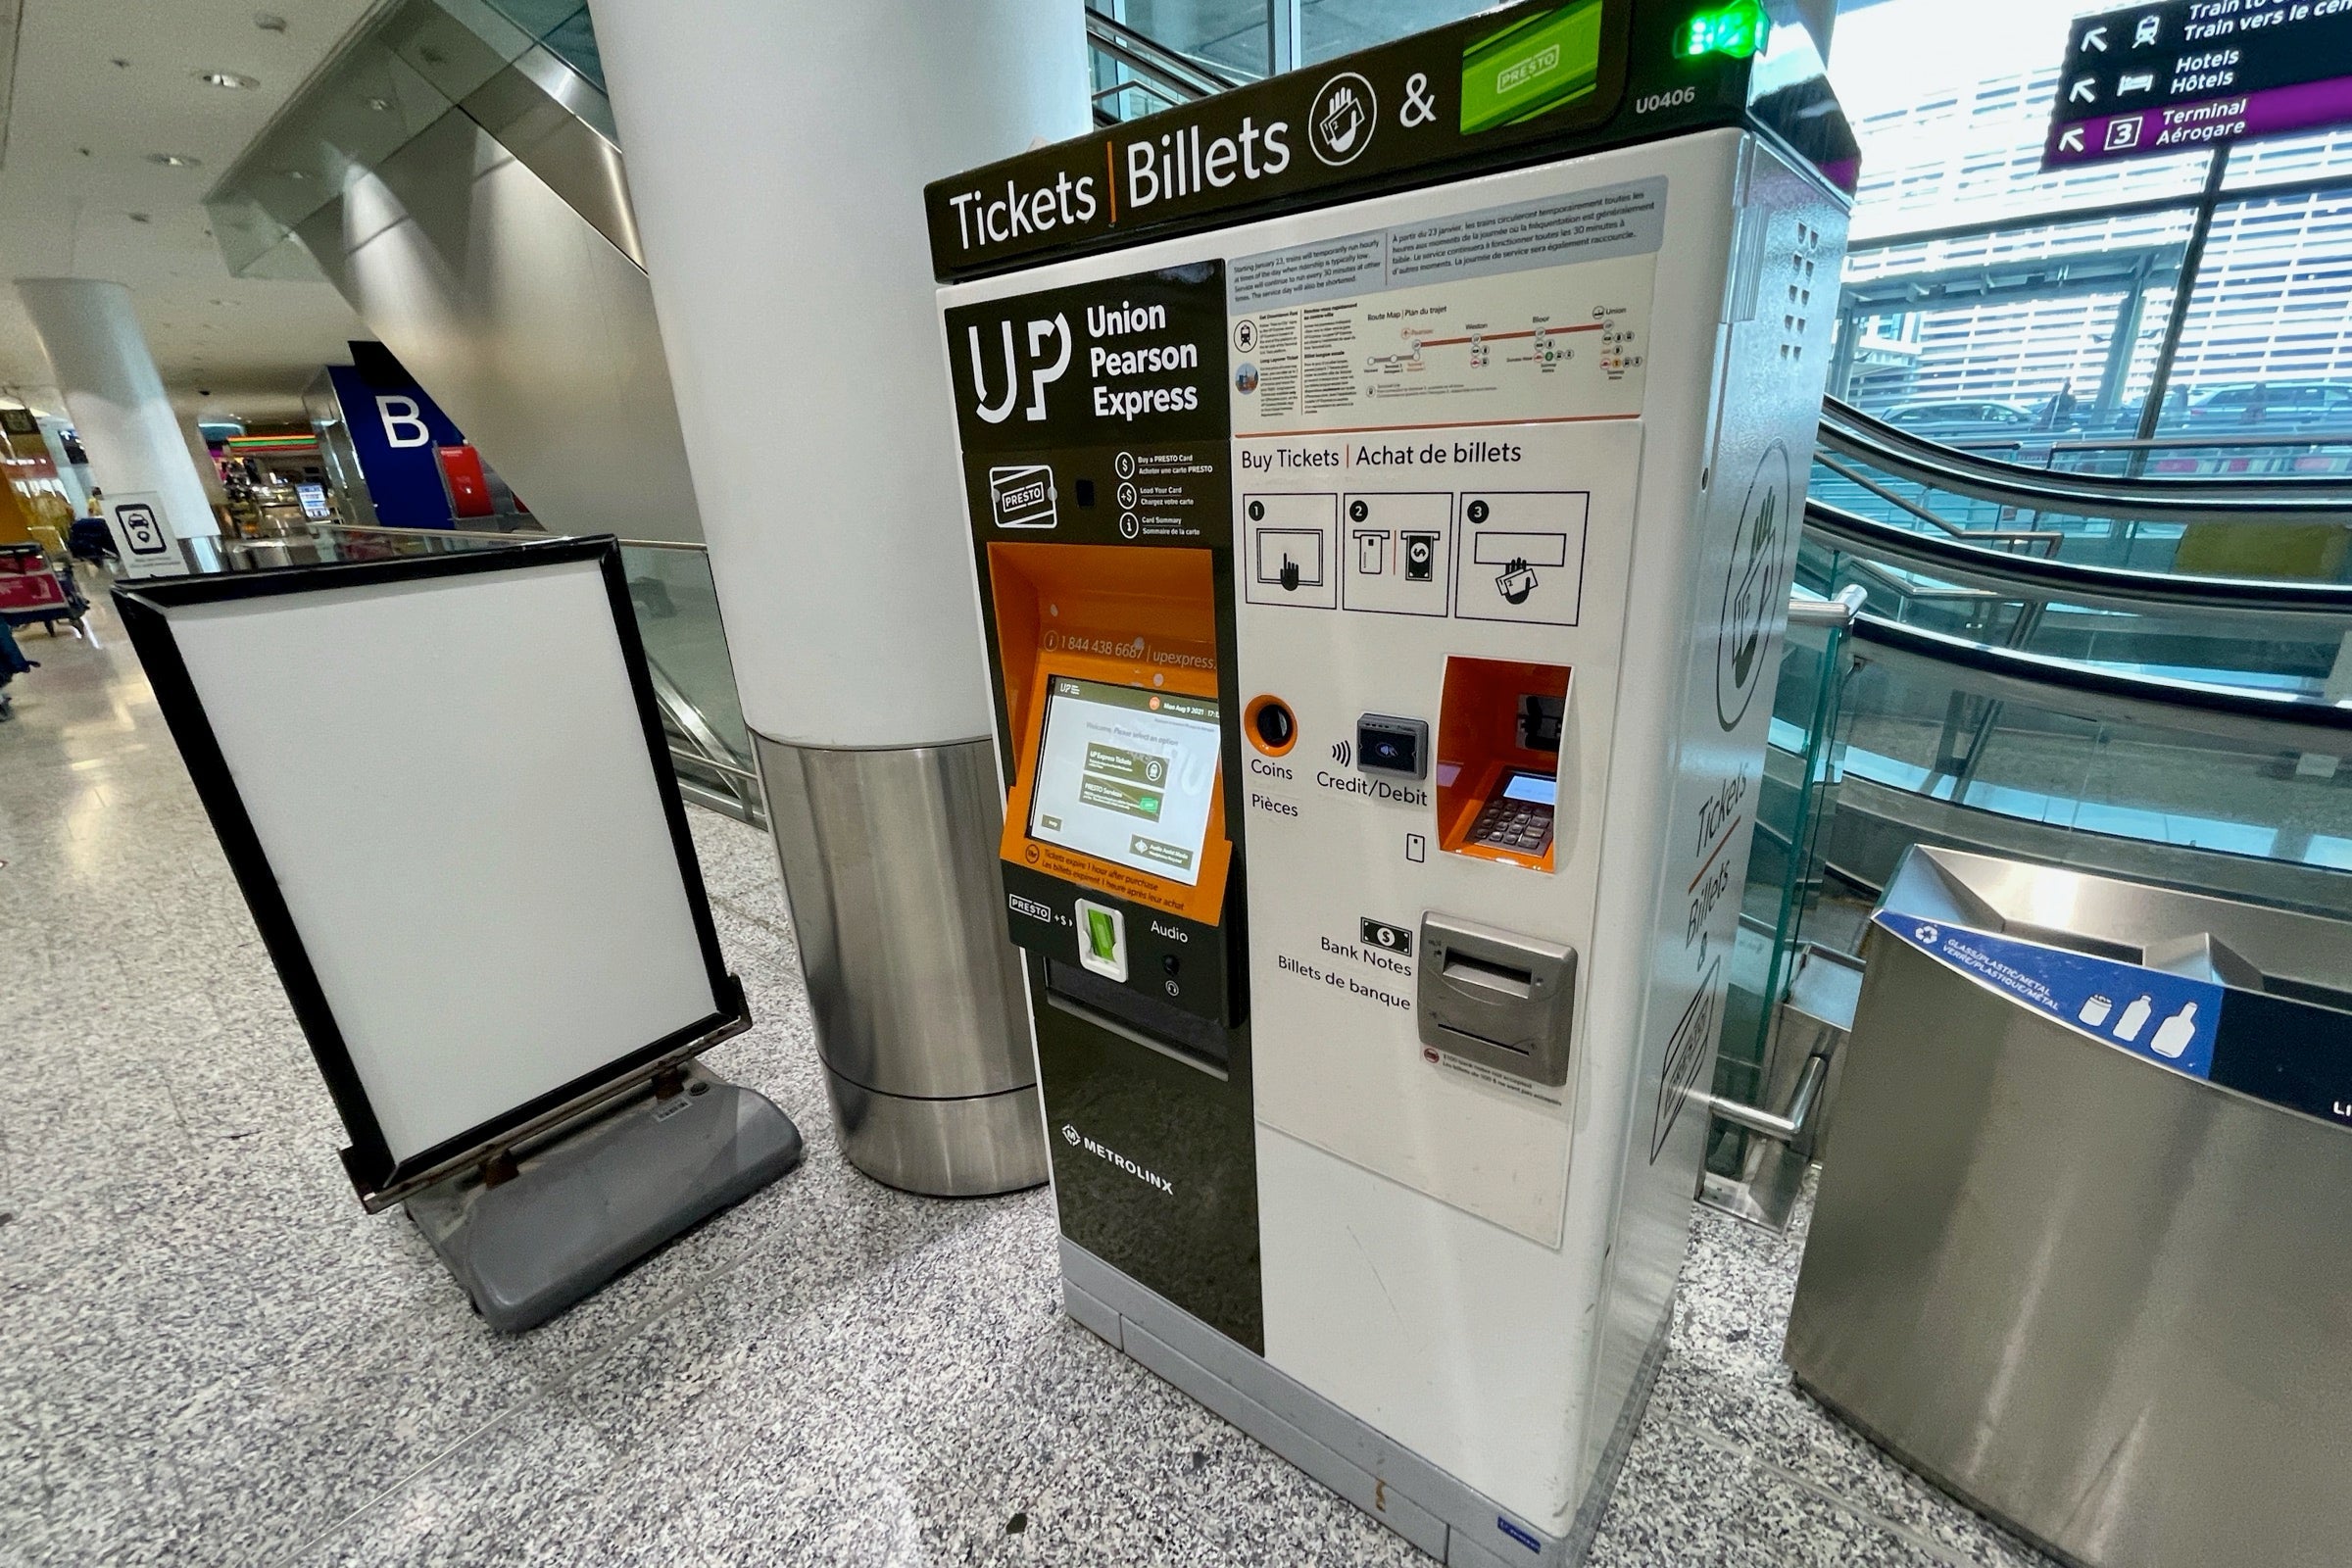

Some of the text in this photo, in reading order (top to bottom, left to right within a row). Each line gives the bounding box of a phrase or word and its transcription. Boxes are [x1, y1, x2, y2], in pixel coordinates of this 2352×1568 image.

[2184, 19, 2233, 41] Train
[2239, 10, 2283, 30] vers
[2288, 4, 2309, 22] le
[2190, 0, 2239, 20] Train
[1501, 52, 1555, 87] PRESTO
[2176, 50, 2239, 74] Hotels
[2171, 71, 2233, 94] Hôtels
[1636, 86, 1695, 114] U0406
[2114, 99, 2247, 144] 3 Terminal
[2156, 121, 2245, 145] Aérogare
[949, 72, 1437, 250] Tickets Billets &
[1428, 228, 1437, 237] 23
[1497, 211, 1538, 224] circuleront
[1539, 199, 1602, 217] temporairement
[1605, 195, 1631, 205] toutes
[1313, 247, 1348, 259] temporarily
[968, 300, 1166, 424] UP Union
[1090, 343, 1198, 378] Pearson
[1094, 386, 1198, 421] Express
[375, 396, 430, 448] B
[1242, 442, 1522, 472] Buy Tickets Achat de billets
[1005, 487, 1041, 508] PRESTO
[1253, 505, 1259, 516] 1
[1354, 506, 1363, 516] 2
[1474, 506, 1483, 518] 3
[1061, 636, 1065, 649] 1
[1068, 637, 1090, 652] 844
[1092, 639, 1112, 655] 438
[1115, 642, 1145, 659] 6687
[1191, 707, 1203, 715] 2021
[1158, 737, 1179, 747] option
[1250, 759, 1294, 781] Coins
[1316, 770, 1428, 807] Credit/Debit
[1251, 794, 1298, 817] Pièces
[1695, 761, 1749, 858] Tickets
[1045, 850, 1064, 861] Tickets
[1066, 857, 1086, 868] expire
[1092, 864, 1107, 875] hour
[1108, 868, 1124, 880] after
[1126, 876, 1158, 891] purchase
[1054, 863, 1072, 876] billets
[1106, 882, 1126, 892] heure
[1127, 887, 1147, 900] après
[1149, 893, 1161, 903] leur
[1163, 899, 1185, 910] achat
[1012, 899, 1049, 918] PRESTO
[1686, 859, 1731, 950] Billets
[1151, 920, 1189, 943] Audio
[1321, 937, 1412, 976] Bank Notes
[1948, 939, 2051, 996] GLASS/PLASTIC/METAL
[1277, 956, 1411, 1010] Billets de banque
[1084, 1137, 1174, 1196] METROLINX
